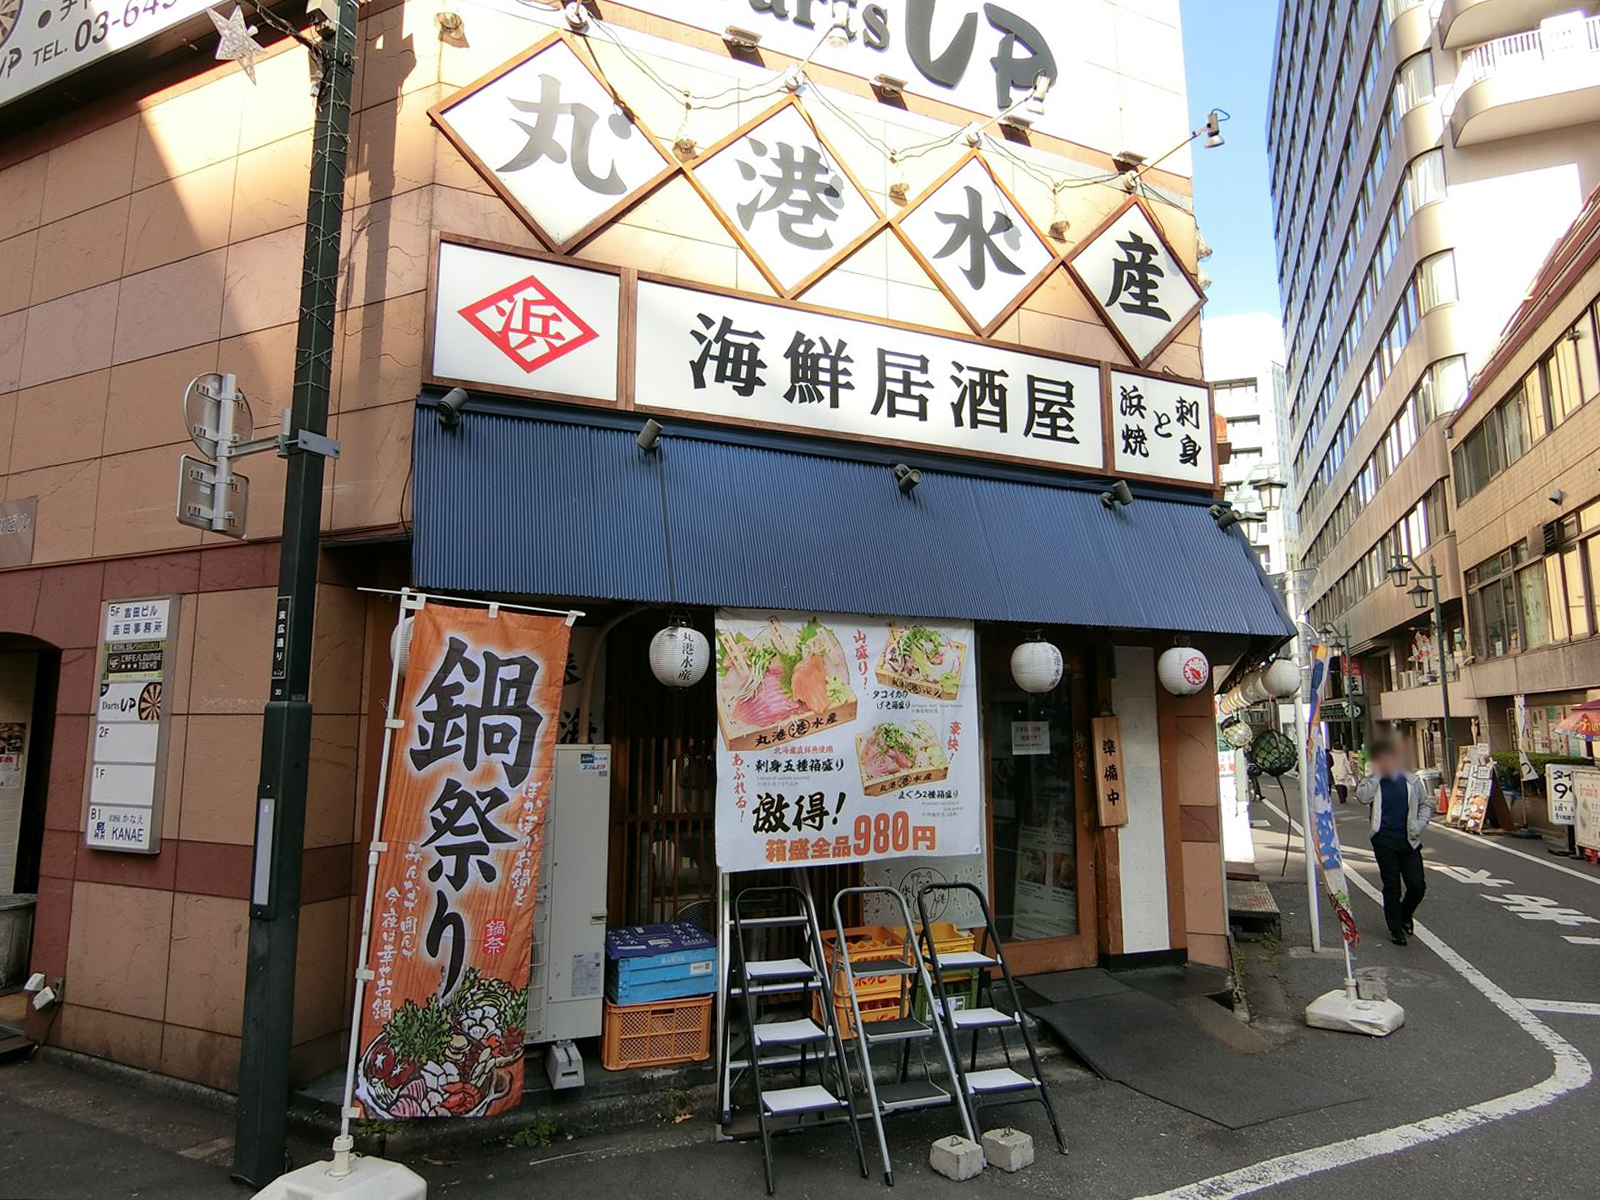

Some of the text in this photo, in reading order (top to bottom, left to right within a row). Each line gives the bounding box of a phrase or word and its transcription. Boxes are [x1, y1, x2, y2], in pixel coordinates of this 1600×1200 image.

[33, 40, 68, 67] TEL.
[74, 0, 178, 53] 03-64
[495, 72, 1172, 324] 丸港水産
[689, 312, 1081, 444] 海鮮居酒屋
[1119, 384, 1202, 467] 刺身 と 浜焼
[110, 605, 159, 619] 5F 吉田ビル
[113, 620, 163, 636] 吉田事務所
[678, 631, 695, 681] 丸港水産
[138, 661, 158, 670] TOKYO
[120, 697, 137, 713] UP
[99, 726, 110, 738] 2F
[95, 767, 106, 779] 1F
[755, 758, 844, 773] 刺身五種箱盛り
[1102, 738, 1121, 807] 準備中
[898, 789, 959, 800] まぐろ2種箱盛り
[1553, 782, 1573, 799] 9
[91, 808, 102, 820] B1
[409, 636, 544, 999] 鍋祭り
[111, 826, 144, 843] KANAE
[484, 919, 506, 956] 鍋祭
